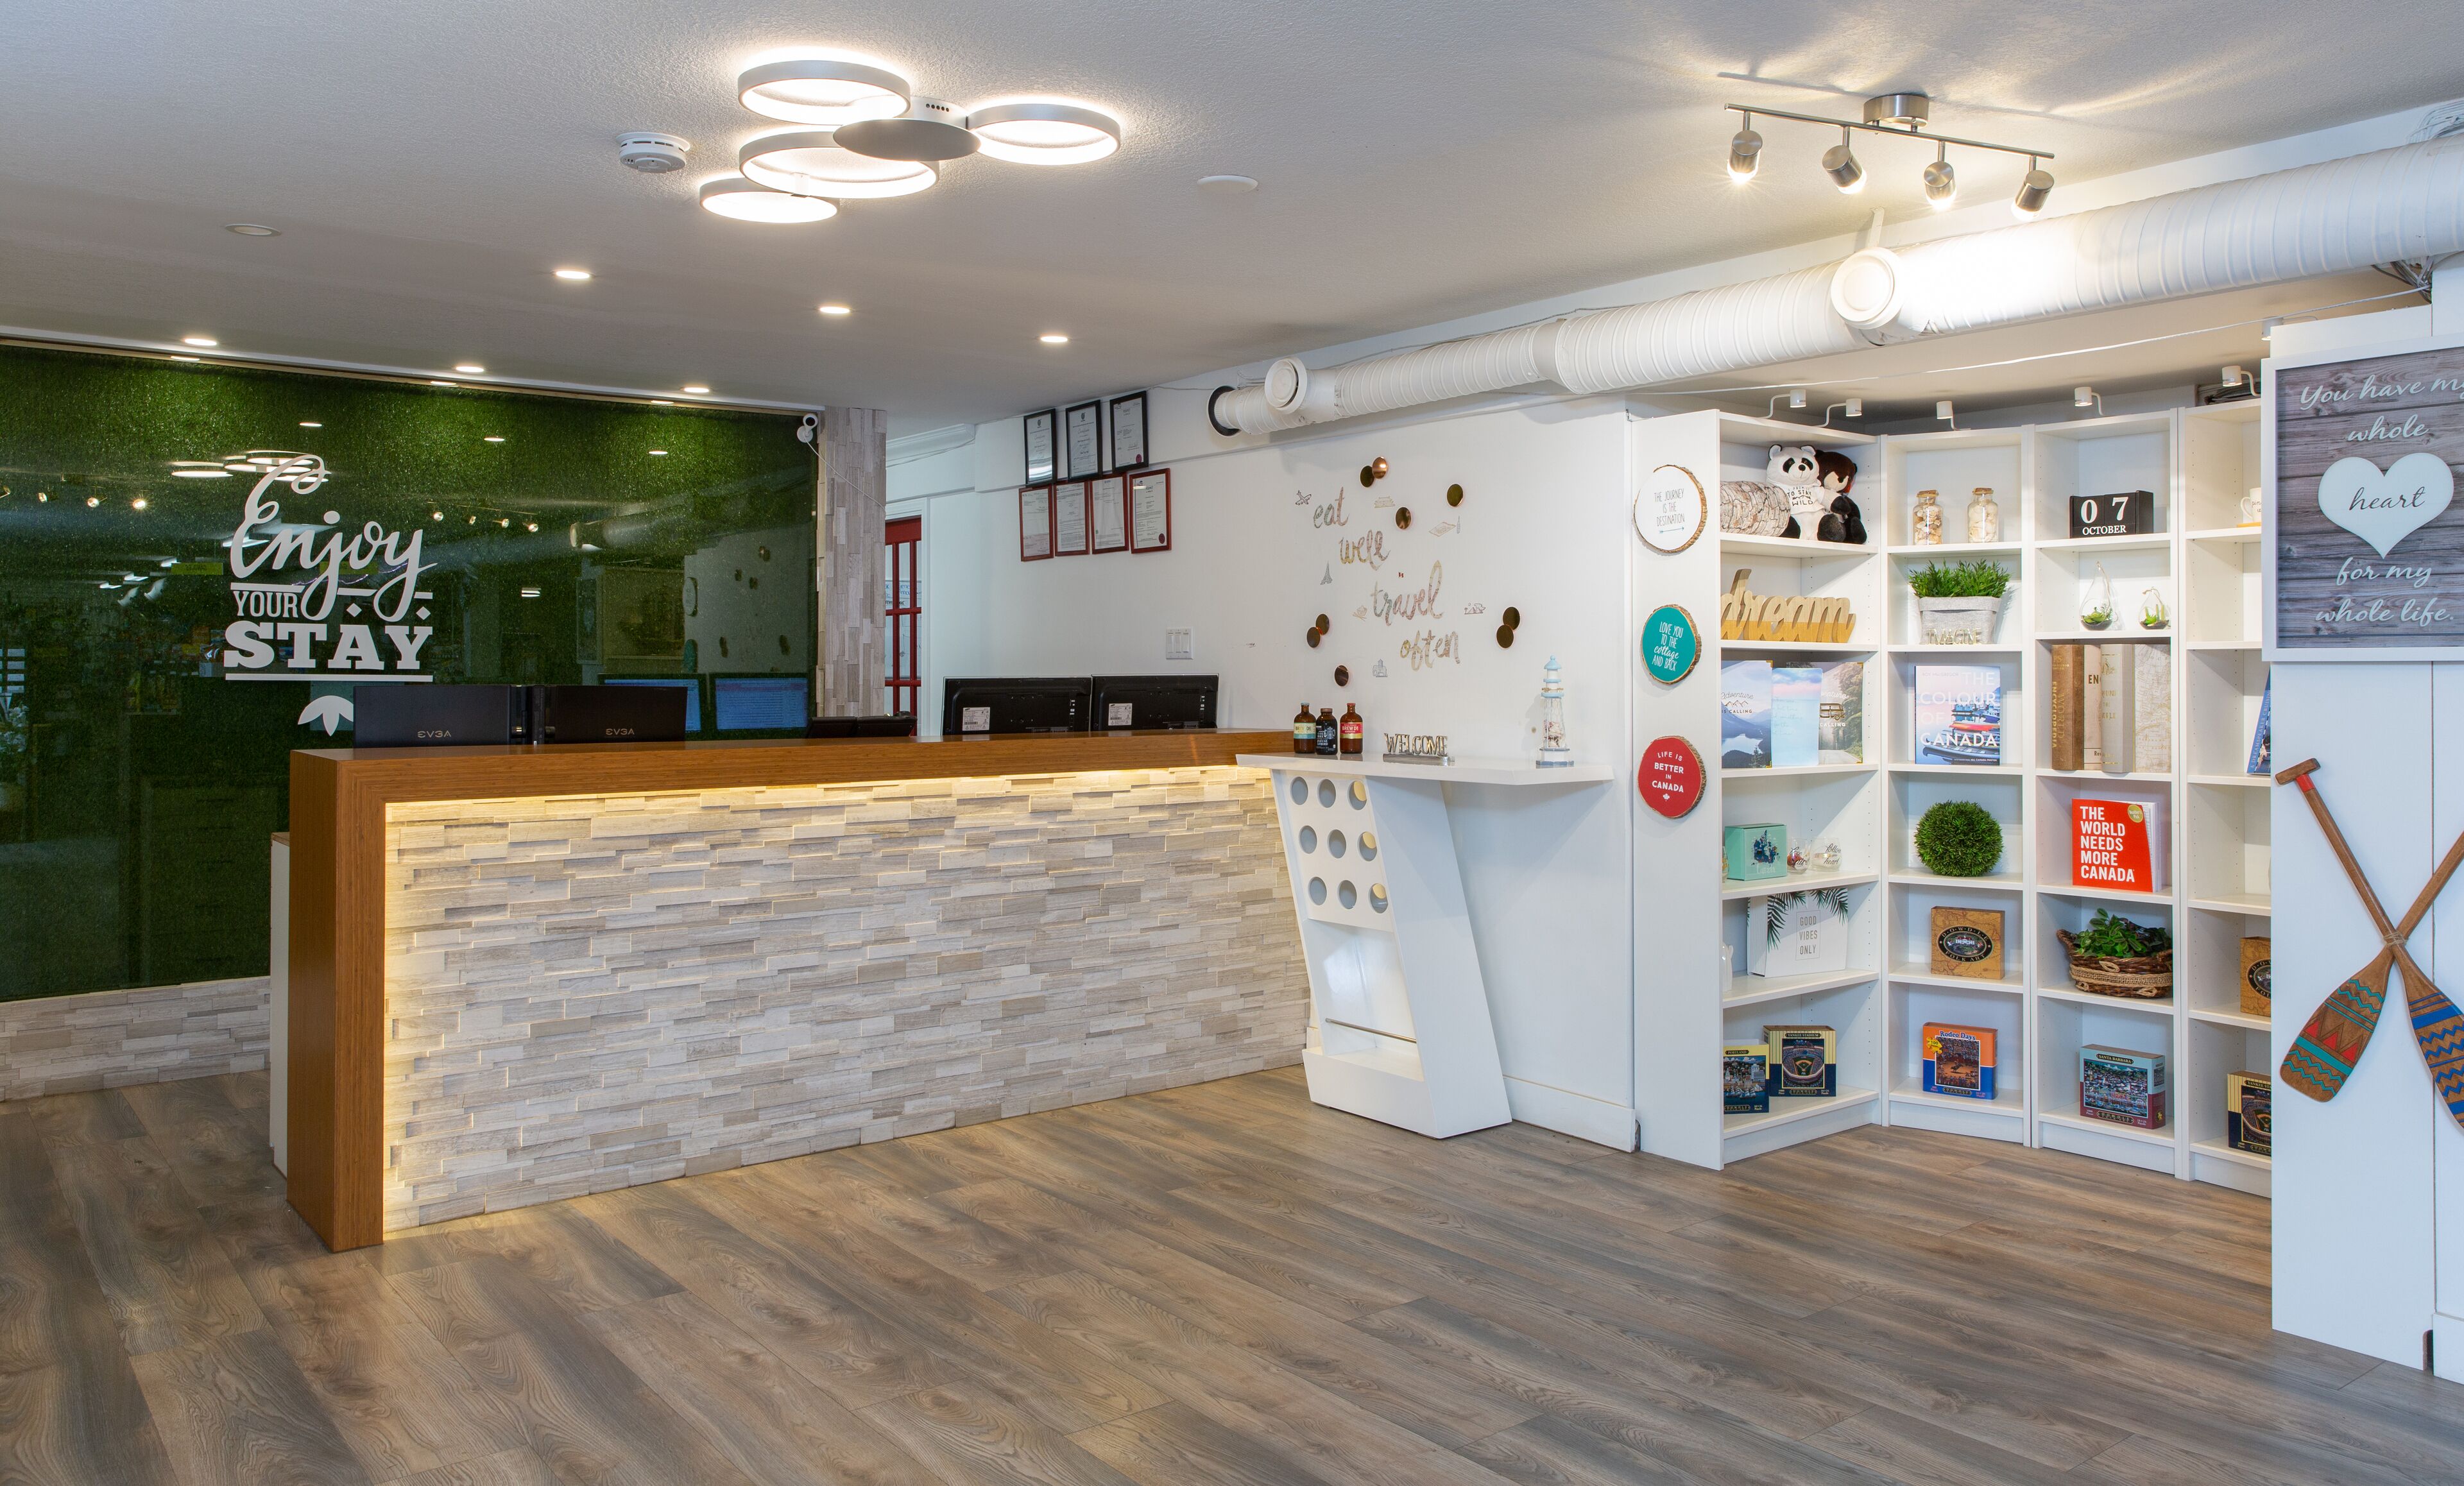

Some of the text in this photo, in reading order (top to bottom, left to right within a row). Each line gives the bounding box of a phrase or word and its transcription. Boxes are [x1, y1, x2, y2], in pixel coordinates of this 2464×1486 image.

[2300, 374, 2464, 411] You have m
[2348, 414, 2429, 441] whole
[1654, 488, 1684, 502] THE JOURNEY
[2348, 487, 2426, 511] heart
[1313, 486, 1349, 529] eat
[1663, 502, 1677, 513] IS THE
[1656, 513, 1685, 526] DESTINATION
[230, 454, 438, 622] Enjoy
[2082, 525, 2127, 536] OCTOBER
[1339, 529, 1391, 570] well
[2336, 557, 2432, 588] for my
[1371, 560, 1444, 626] travel
[233, 590, 299, 618] YOUR
[1721, 568, 1856, 643] dream
[2315, 598, 2395, 622] whole
[1659, 621, 1684, 638] LOVE YOU
[223, 620, 433, 670] STAY
[1661, 634, 1678, 649] TO THE
[1400, 629, 1460, 671] often
[1654, 645, 1679, 661] cottage
[1652, 654, 1677, 672] AND BACK
[1962, 672, 1995, 685] THE
[1920, 692, 1998, 705] COLOUR
[1921, 712, 1945, 725] OF
[1383, 733, 1448, 756] WELCOME
[1920, 733, 1998, 746] CANADA
[1654, 762, 1684, 774] BETTER
[1652, 780, 1684, 793] CANADA
[2080, 806, 2105, 821] THE
[2080, 821, 2125, 837] WORLD
[2080, 835, 2123, 851] NEEDS
[2080, 850, 2118, 866] MORE
[2081, 865, 2135, 882] CANADA
[1800, 916, 1817, 926] GOOD
[1799, 930, 1817, 940] VIBES
[1799, 944, 1817, 955] ONLY
[1945, 950, 1986, 962] FOLK ART
[1961, 1032, 1976, 1041] Days
